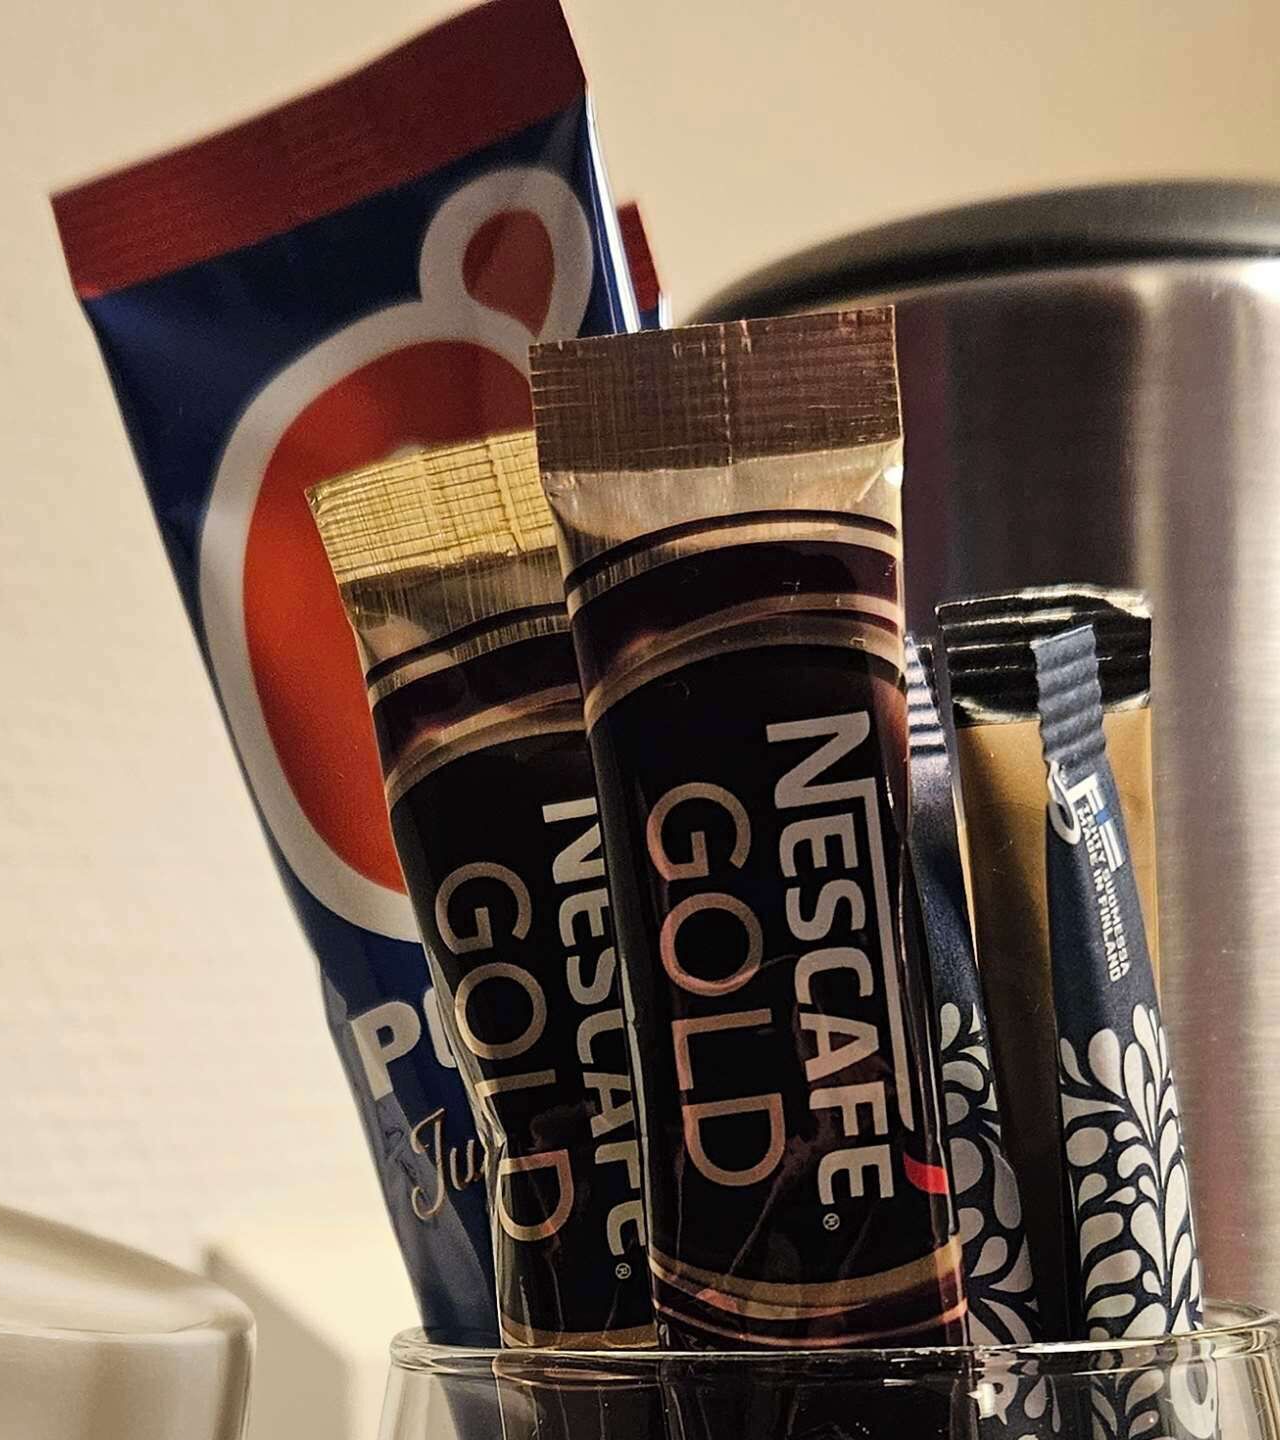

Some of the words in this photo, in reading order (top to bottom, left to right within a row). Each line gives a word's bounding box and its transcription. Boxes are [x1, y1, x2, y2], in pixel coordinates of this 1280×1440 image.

[1076, 807, 1098, 867] MADE
[1091, 868, 1107, 892] IN
[1097, 894, 1123, 983] FINLAND
[1101, 867, 1131, 978] SUOMESSA
[646, 782, 788, 1188] GOLD
[434, 861, 575, 1242] GOLD
